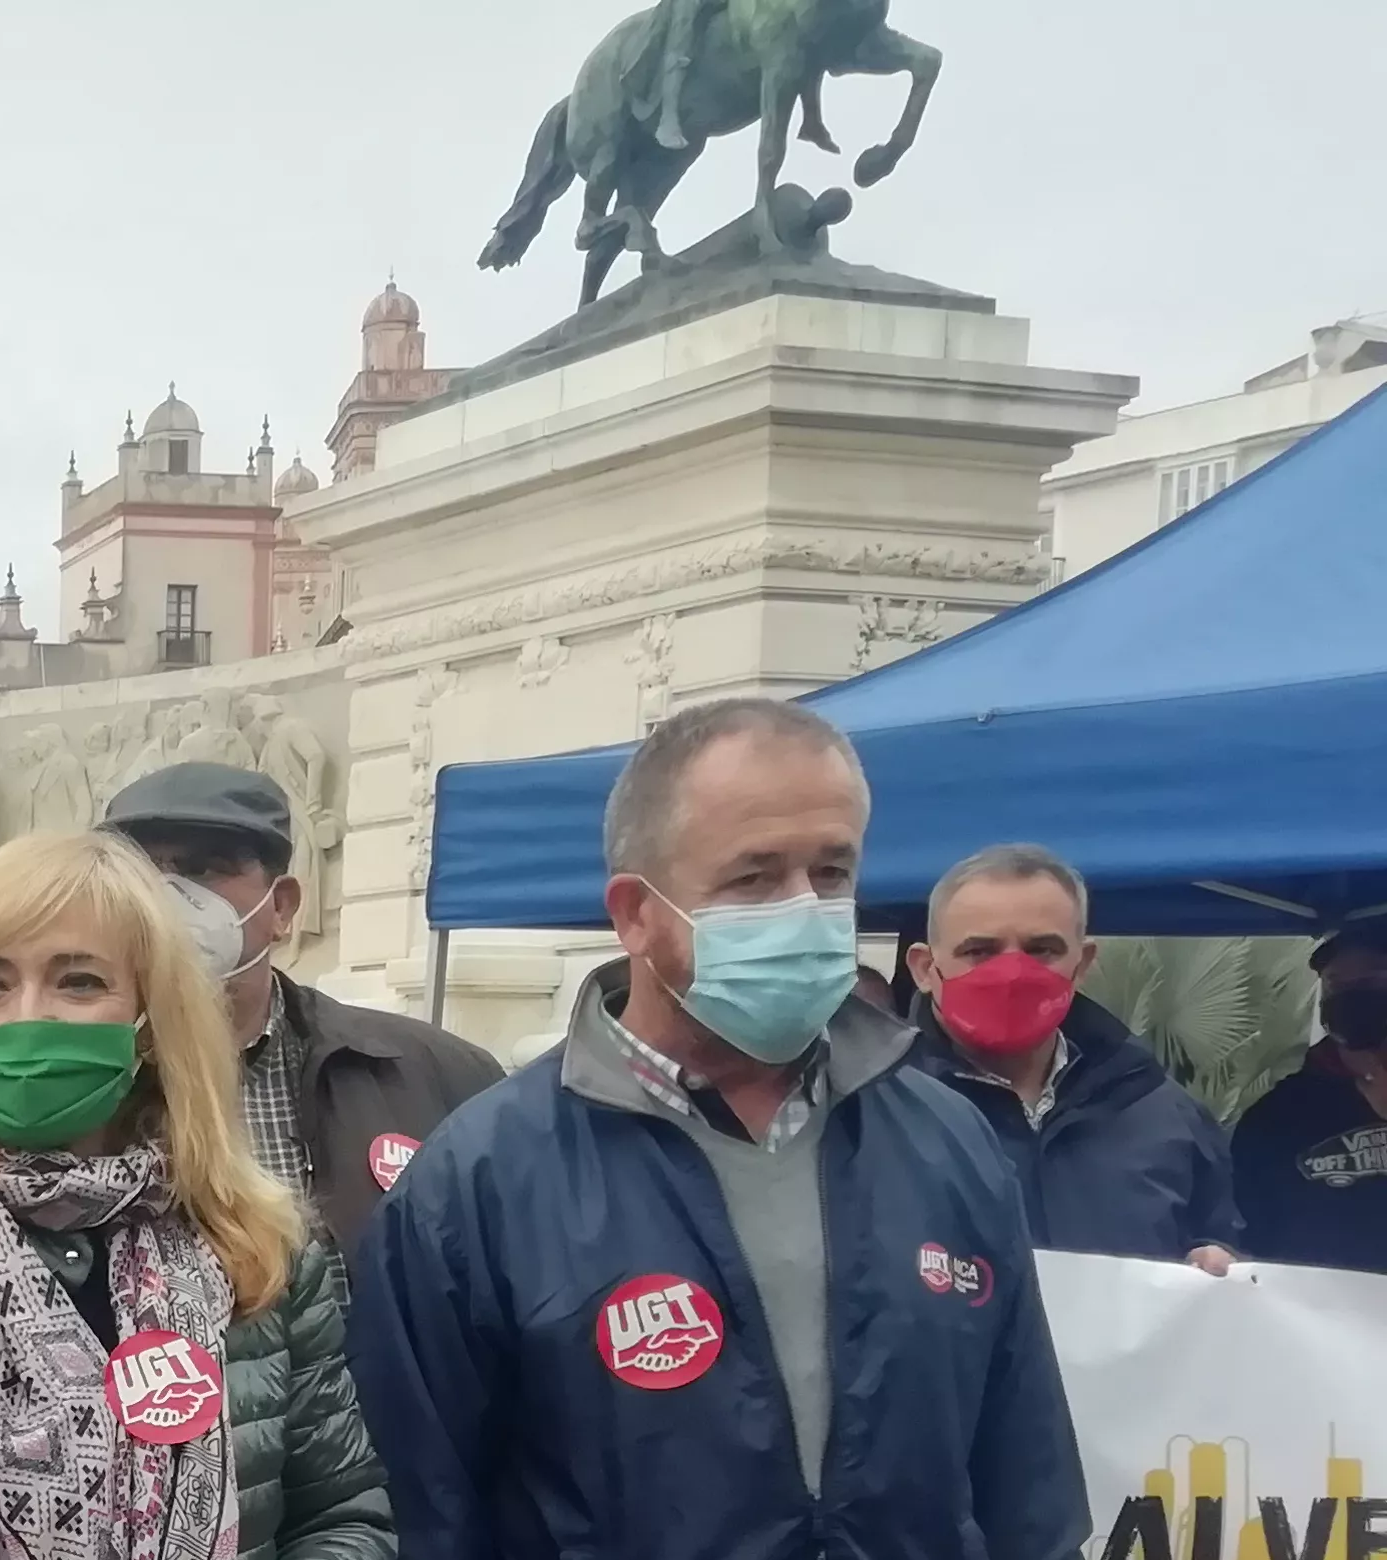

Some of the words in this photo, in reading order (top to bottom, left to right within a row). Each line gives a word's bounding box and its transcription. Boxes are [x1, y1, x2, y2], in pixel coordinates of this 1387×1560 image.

[920, 1249, 949, 1272] UGT
[607, 1283, 701, 1350] UGT
[112, 1338, 202, 1406] UGT
